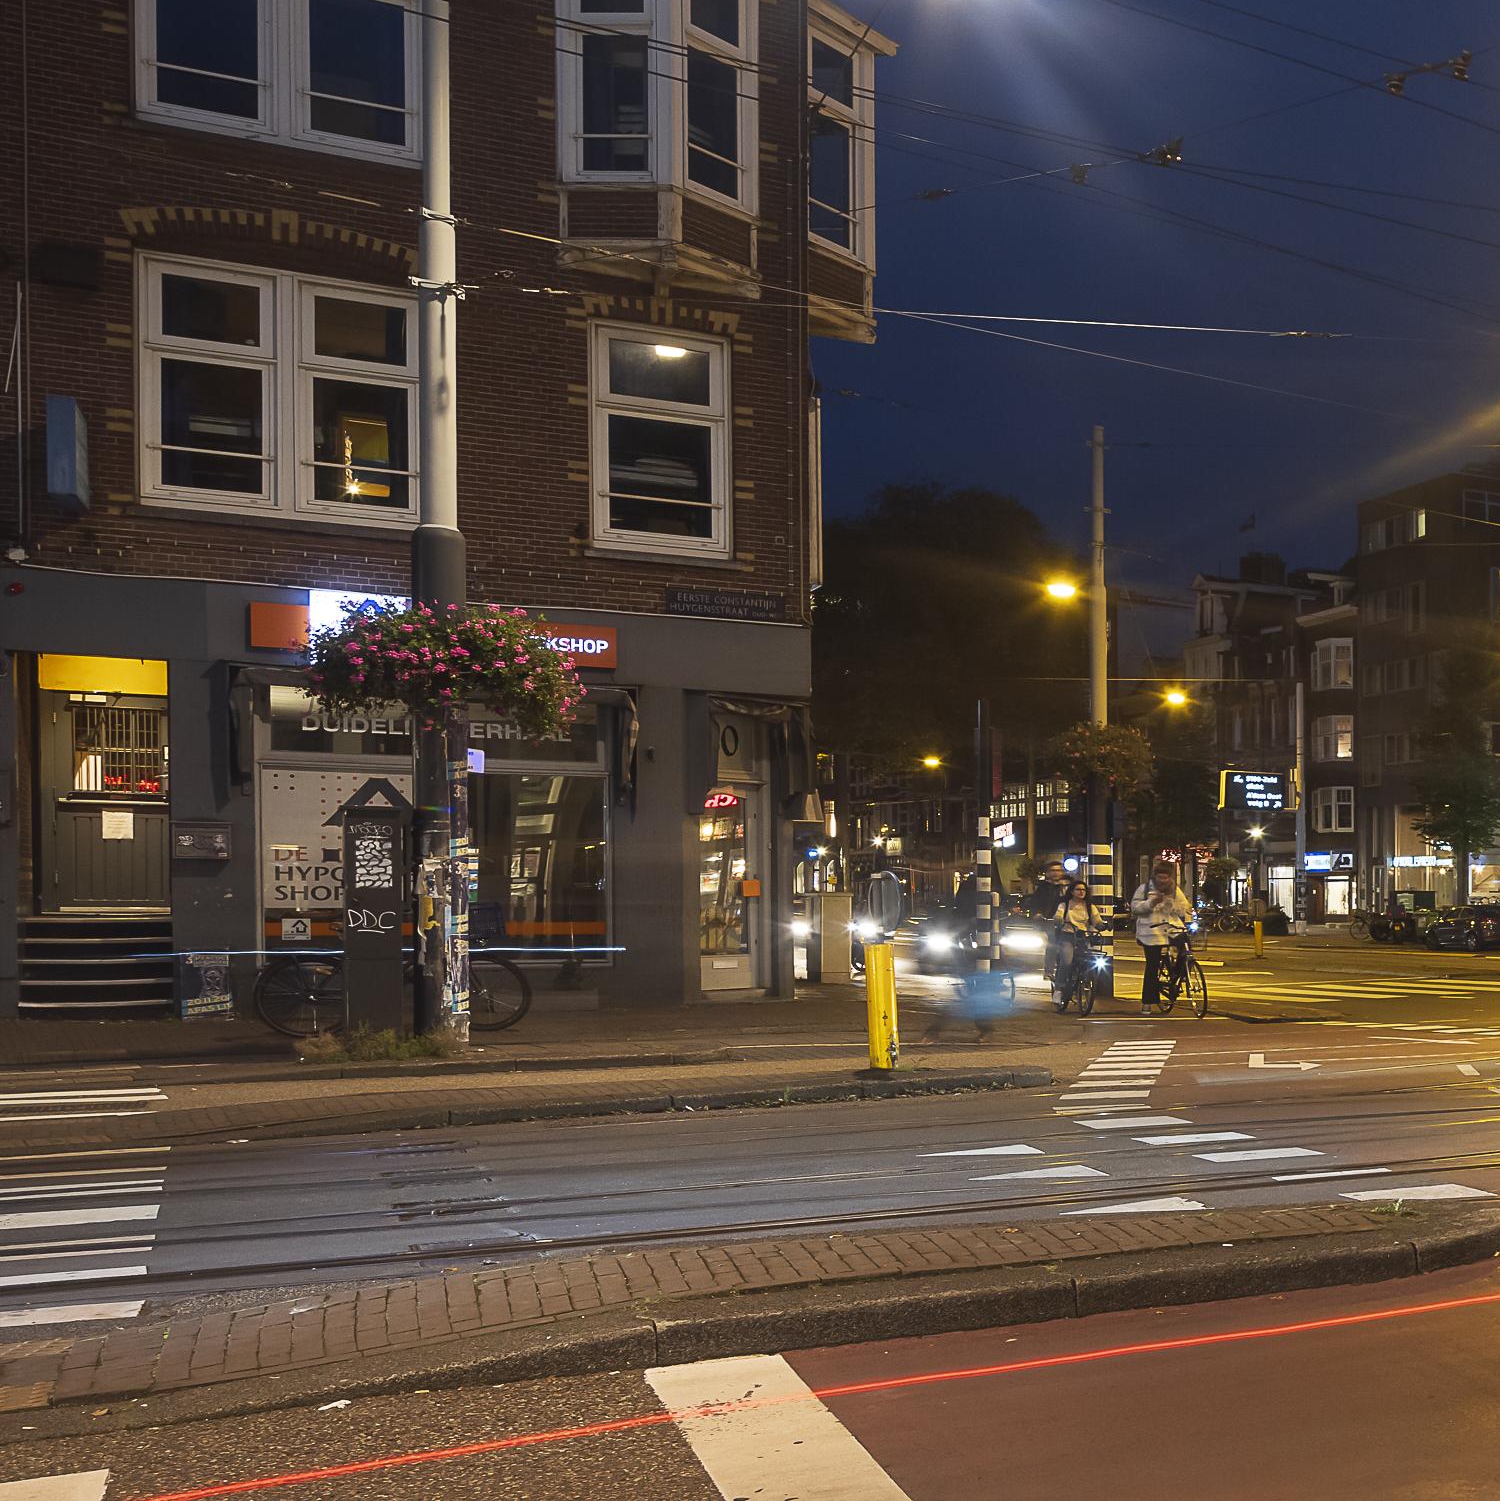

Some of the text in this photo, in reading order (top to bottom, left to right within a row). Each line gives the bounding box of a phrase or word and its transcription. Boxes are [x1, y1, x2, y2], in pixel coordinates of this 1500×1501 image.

[670, 603, 749, 617] HUYGENSSTRAAT
[676, 591, 777, 610] EERSTE CONSTANTIJN
[347, 909, 397, 929] DDC
